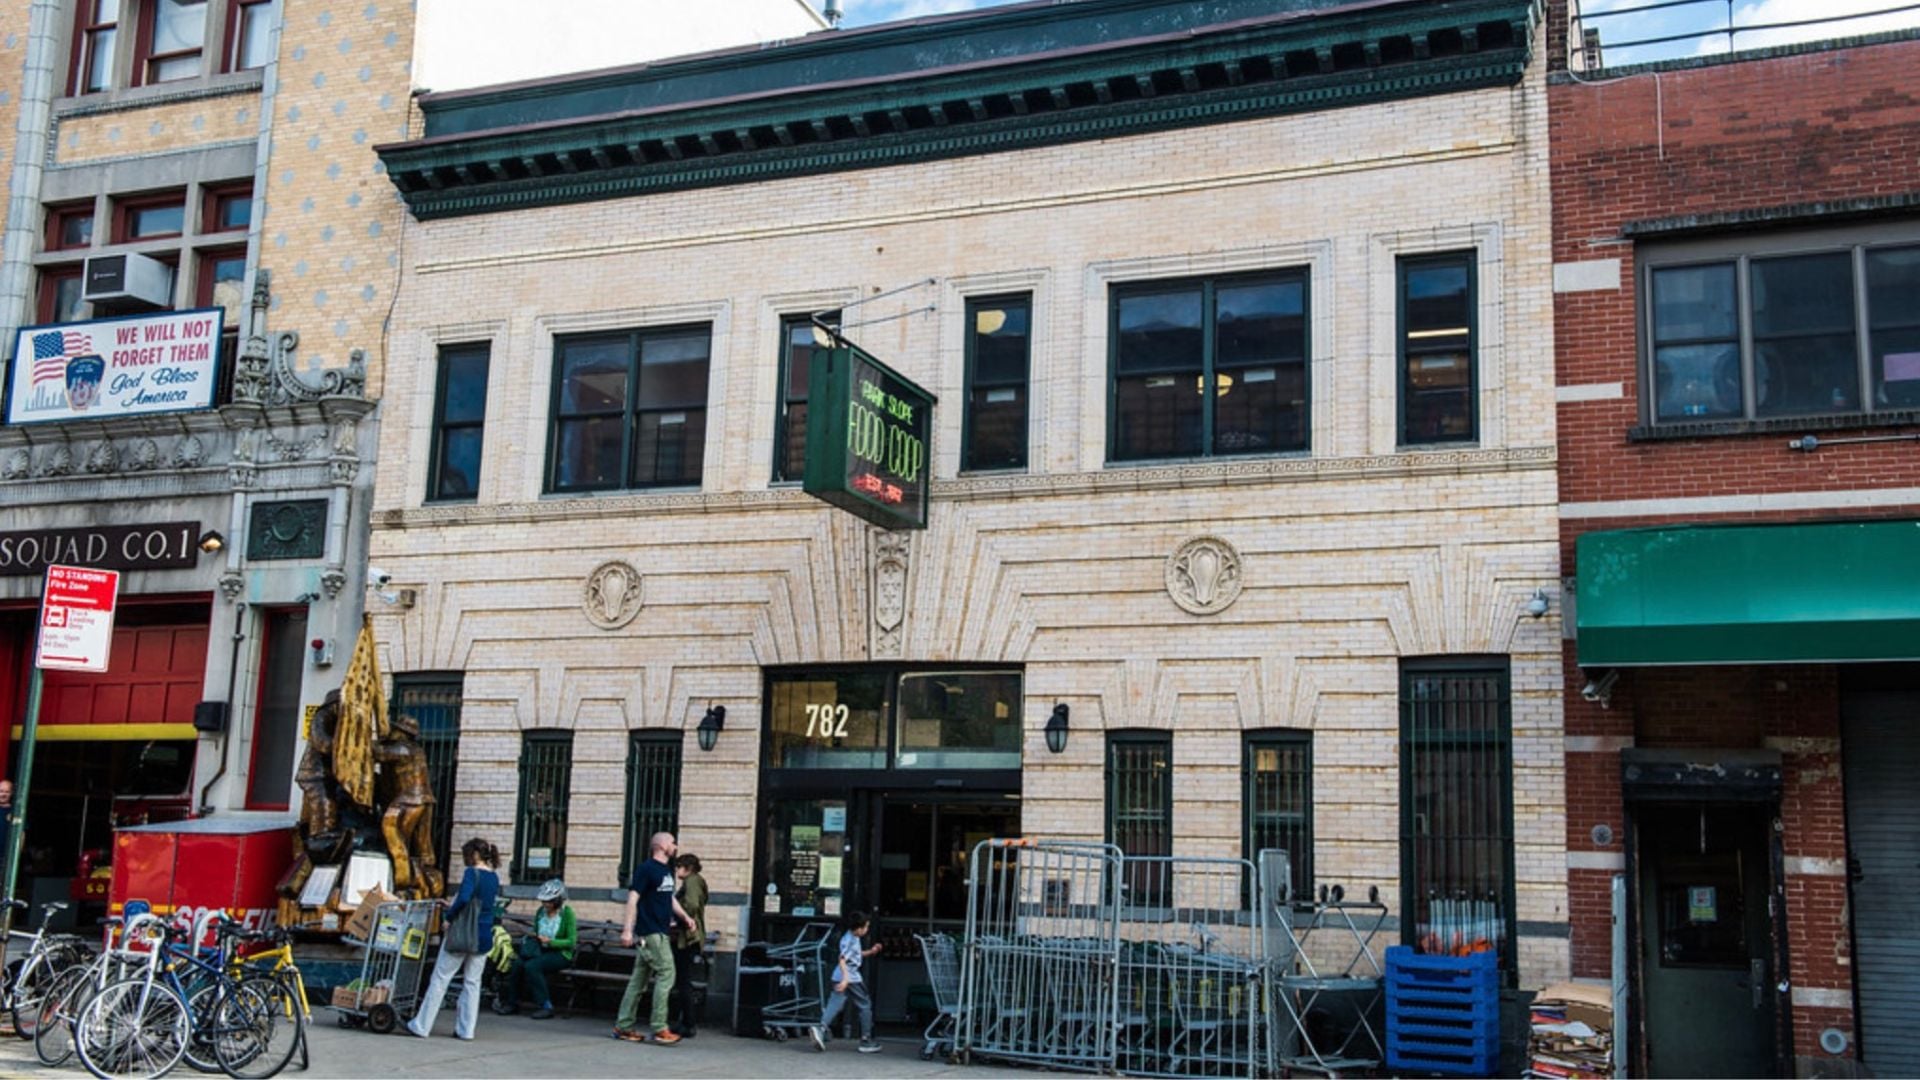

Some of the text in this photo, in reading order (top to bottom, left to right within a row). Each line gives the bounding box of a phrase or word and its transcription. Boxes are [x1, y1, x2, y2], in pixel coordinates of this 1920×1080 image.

[117, 320, 212, 345] WE WILL NOT
[112, 346, 164, 368] FORGET
[170, 343, 209, 362] THEM
[109, 367, 199, 395] God Bless
[121, 388, 188, 407] America
[888, 394, 913, 426] SLOPE
[848, 401, 924, 483] FOOD COOP
[0, 533, 108, 568] SQUAD
[50, 579, 89, 592] Fire Zone
[52, 570, 107, 584] NO STANDING
[805, 703, 849, 737] 782
